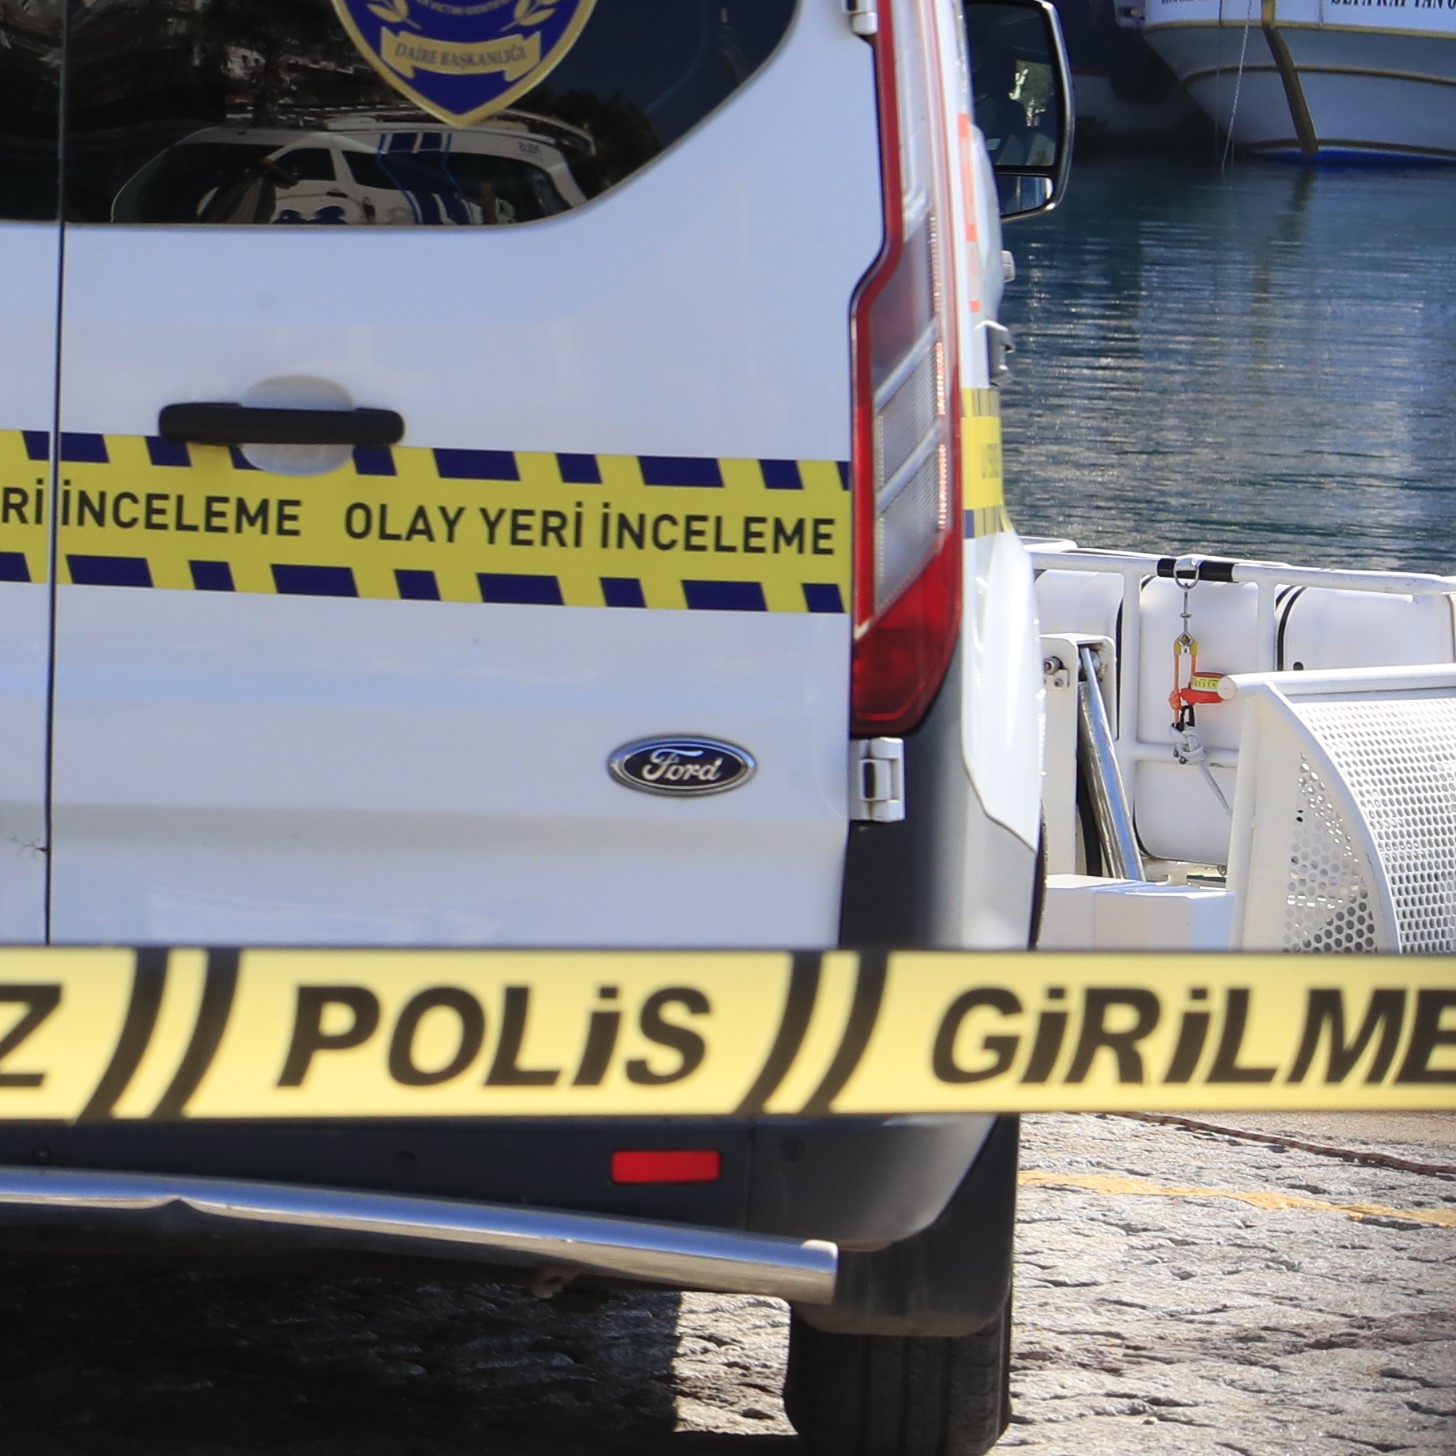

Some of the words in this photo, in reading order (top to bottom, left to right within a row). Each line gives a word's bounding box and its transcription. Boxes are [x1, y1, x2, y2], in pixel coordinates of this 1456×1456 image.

[60, 478, 303, 538] İNCELEME
[344, 501, 466, 544] OLAY
[479, 500, 584, 549] YERİ
[600, 501, 837, 556] İNCELEME
[641, 748, 724, 781] Ford
